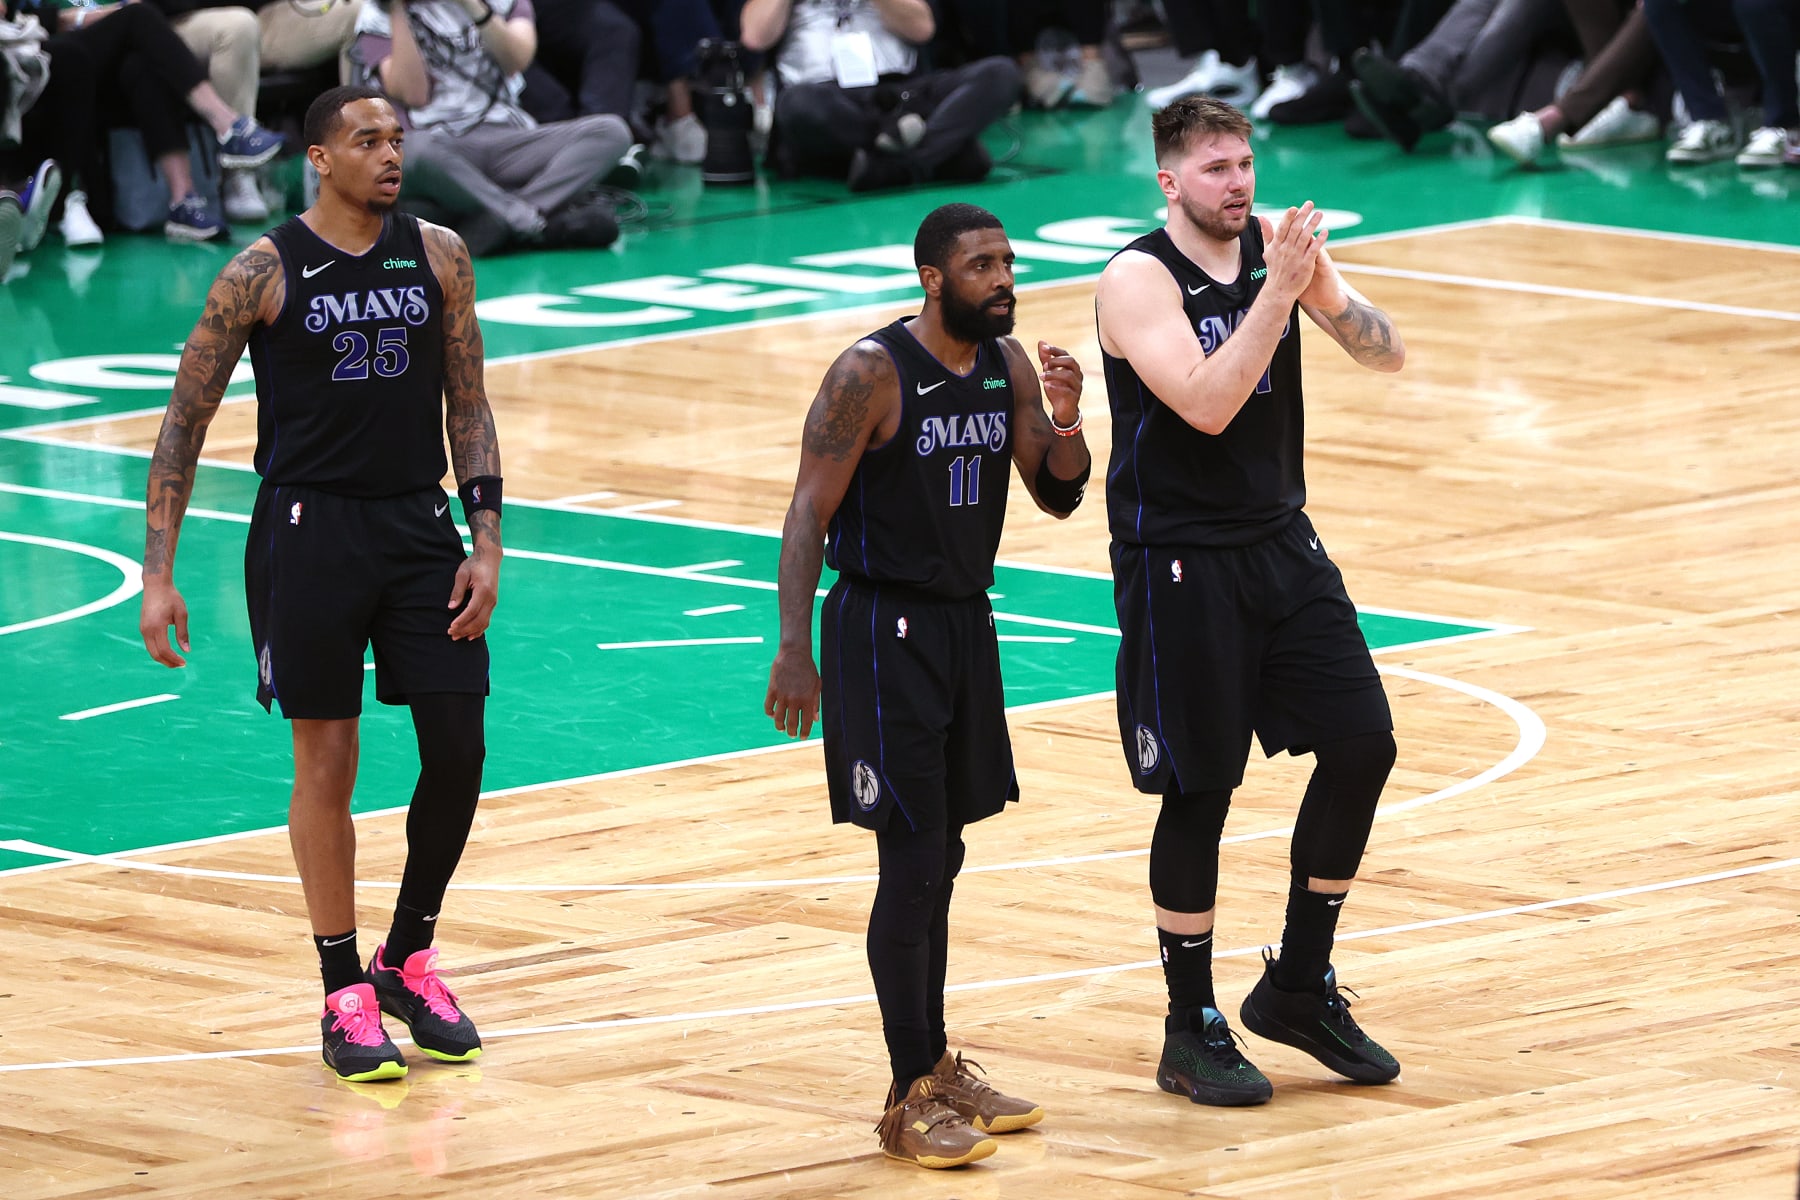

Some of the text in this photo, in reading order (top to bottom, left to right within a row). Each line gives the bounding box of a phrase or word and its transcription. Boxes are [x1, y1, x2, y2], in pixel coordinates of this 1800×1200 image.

[383, 257, 418, 270] chime
[304, 285, 430, 334] MAVS
[331, 326, 410, 381] 25
[983, 377, 1007, 390] chime
[915, 410, 1008, 456] MAVS
[948, 455, 982, 507] 11
